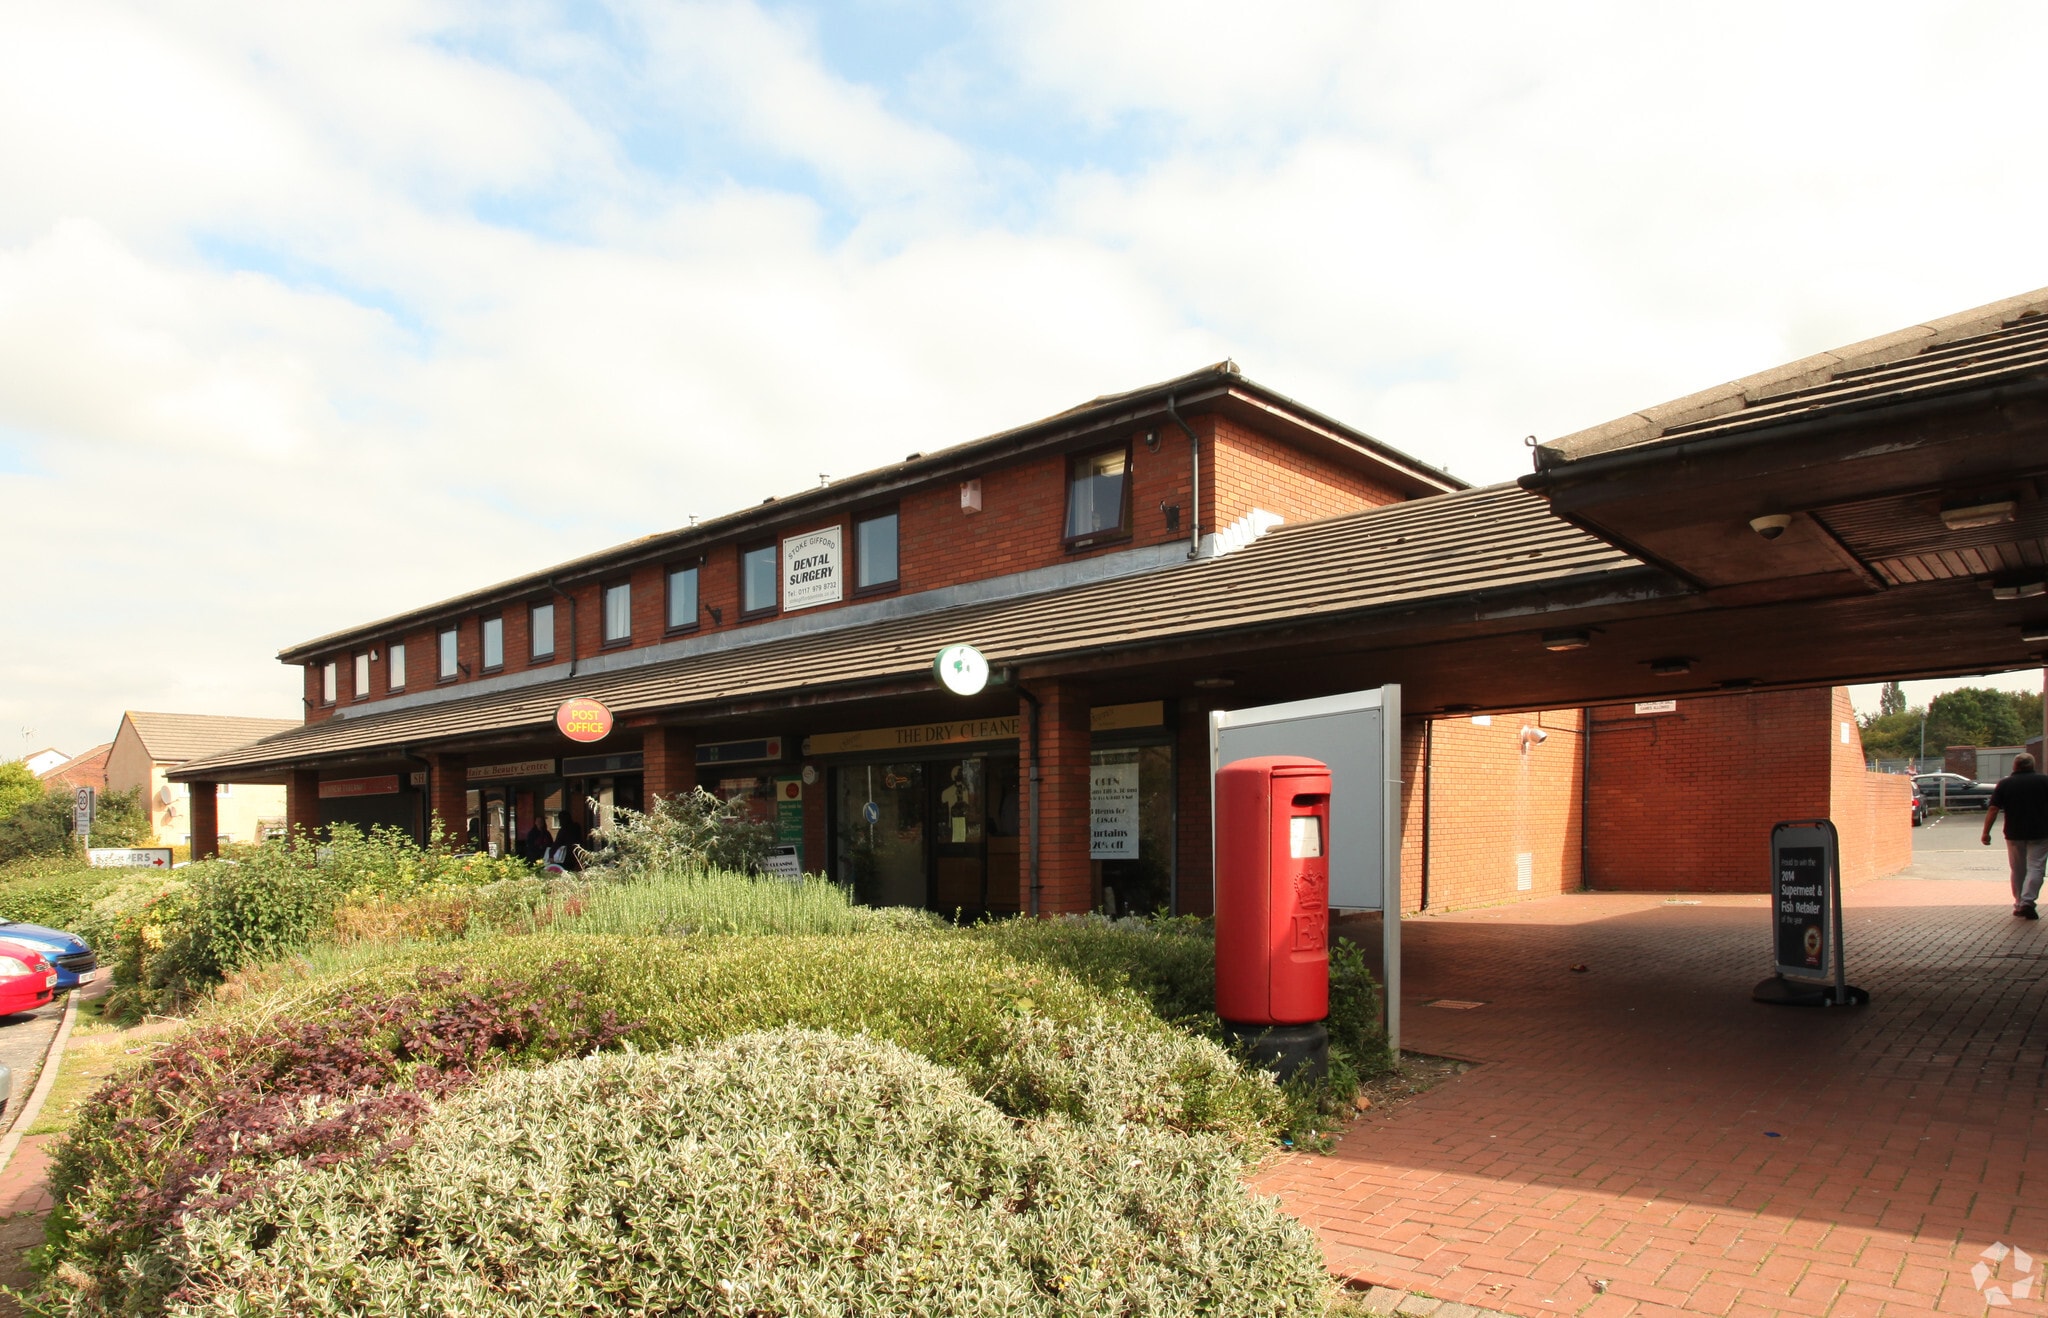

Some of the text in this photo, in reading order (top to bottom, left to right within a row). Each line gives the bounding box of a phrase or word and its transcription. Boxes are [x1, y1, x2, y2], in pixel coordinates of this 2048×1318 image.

[788, 536, 836, 560] STOKE GIFFORD
[793, 553, 830, 571] DENTAL
[789, 566, 834, 585] SURGERY
[798, 587, 810, 595] 0117
[812, 584, 822, 592] 979
[823, 581, 837, 590] 8732
[571, 710, 599, 720] POST
[566, 722, 604, 733] OFFICE
[895, 727, 921, 744] THE
[925, 725, 954, 742] DRY
[492, 765, 519, 775] Beauty
[520, 762, 549, 772] Centre
[79, 795, 87, 805] 20
[1781, 870, 1795, 882] 2014
[1781, 884, 1823, 899] Supermeat &
[1781, 901, 1821, 915] Fish Retailer
